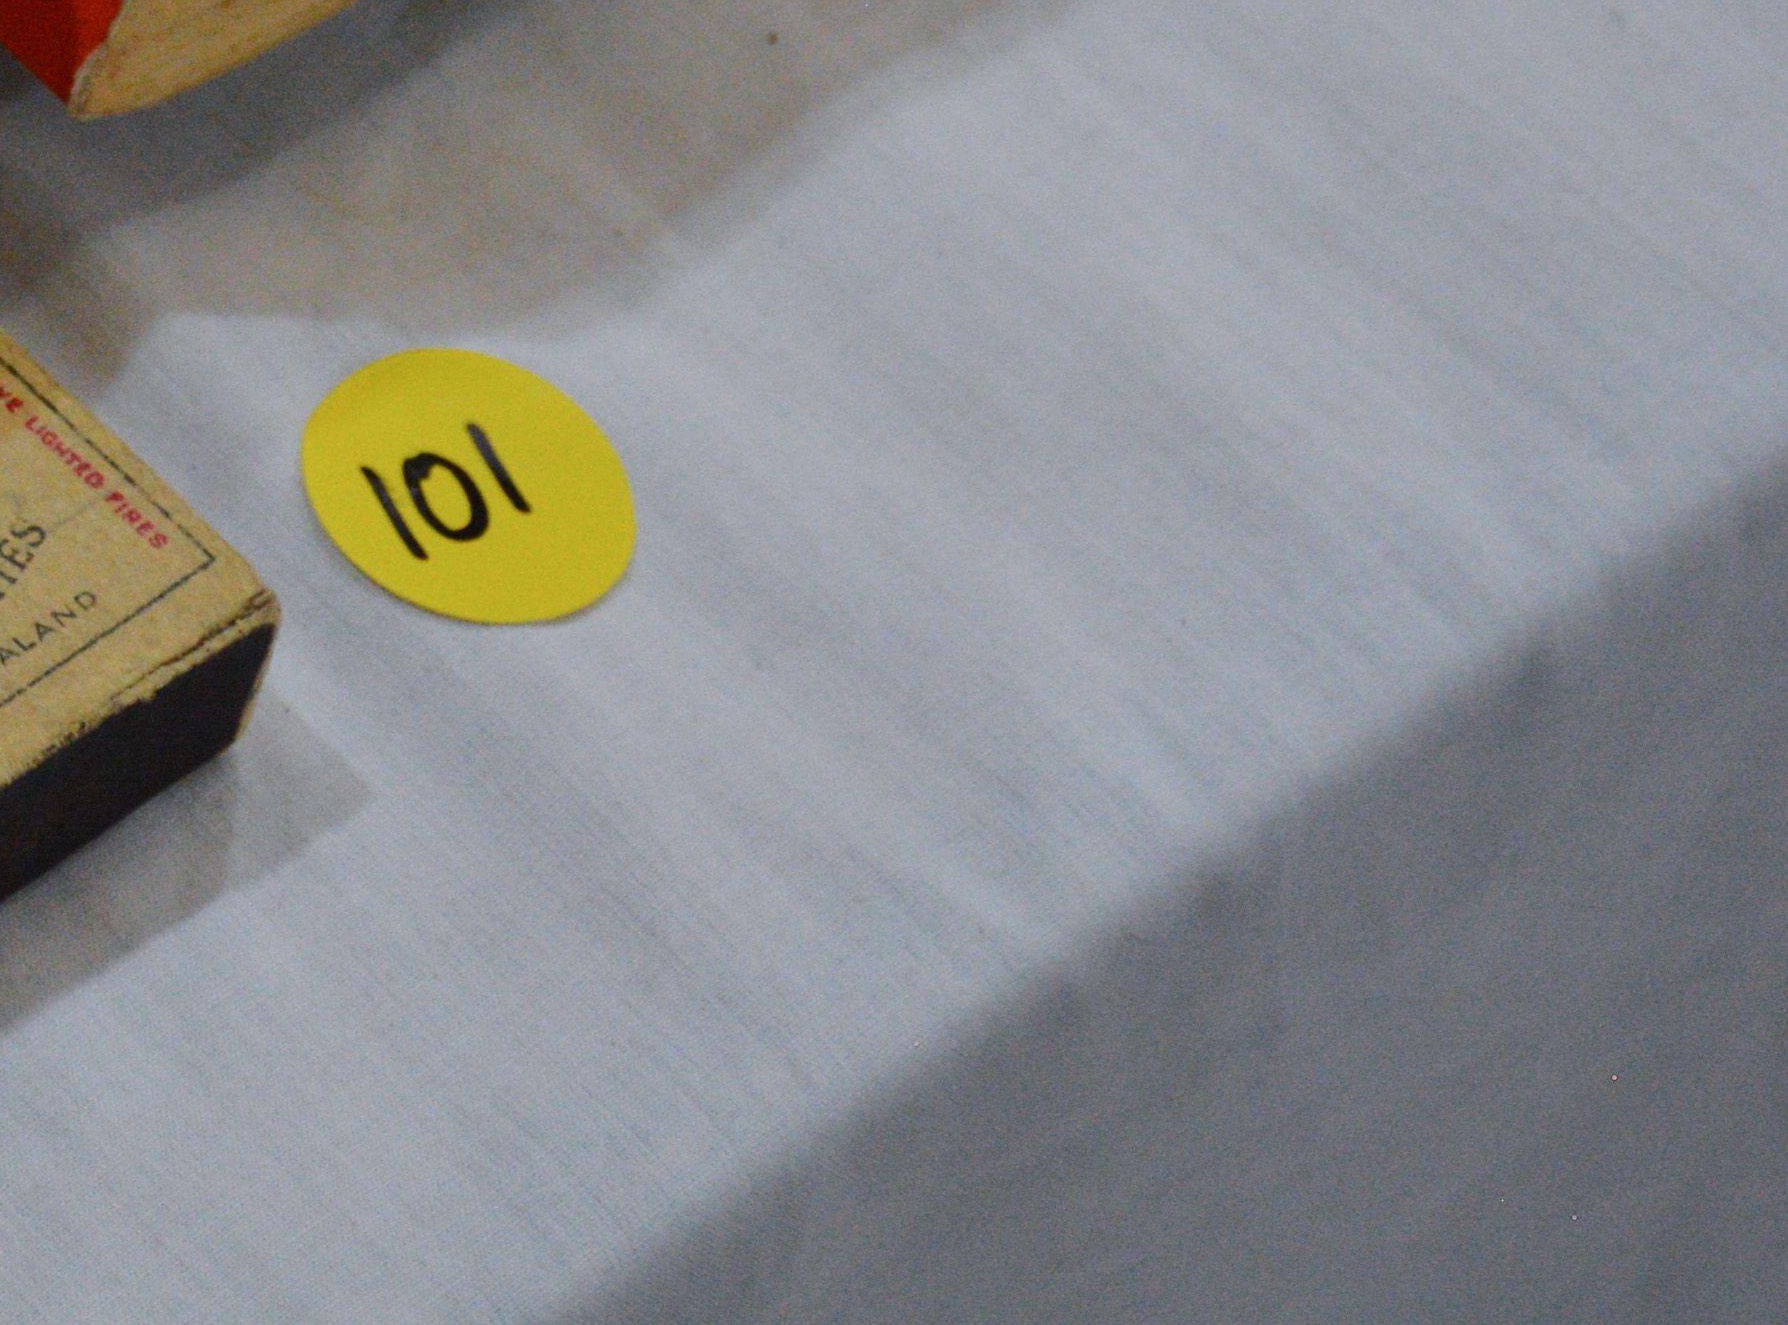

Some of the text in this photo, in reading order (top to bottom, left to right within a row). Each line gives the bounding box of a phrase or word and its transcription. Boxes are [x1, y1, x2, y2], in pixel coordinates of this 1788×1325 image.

[25, 415, 106, 490] LIGHTED
[105, 490, 170, 550] FIRES
[359, 420, 532, 562] 101
